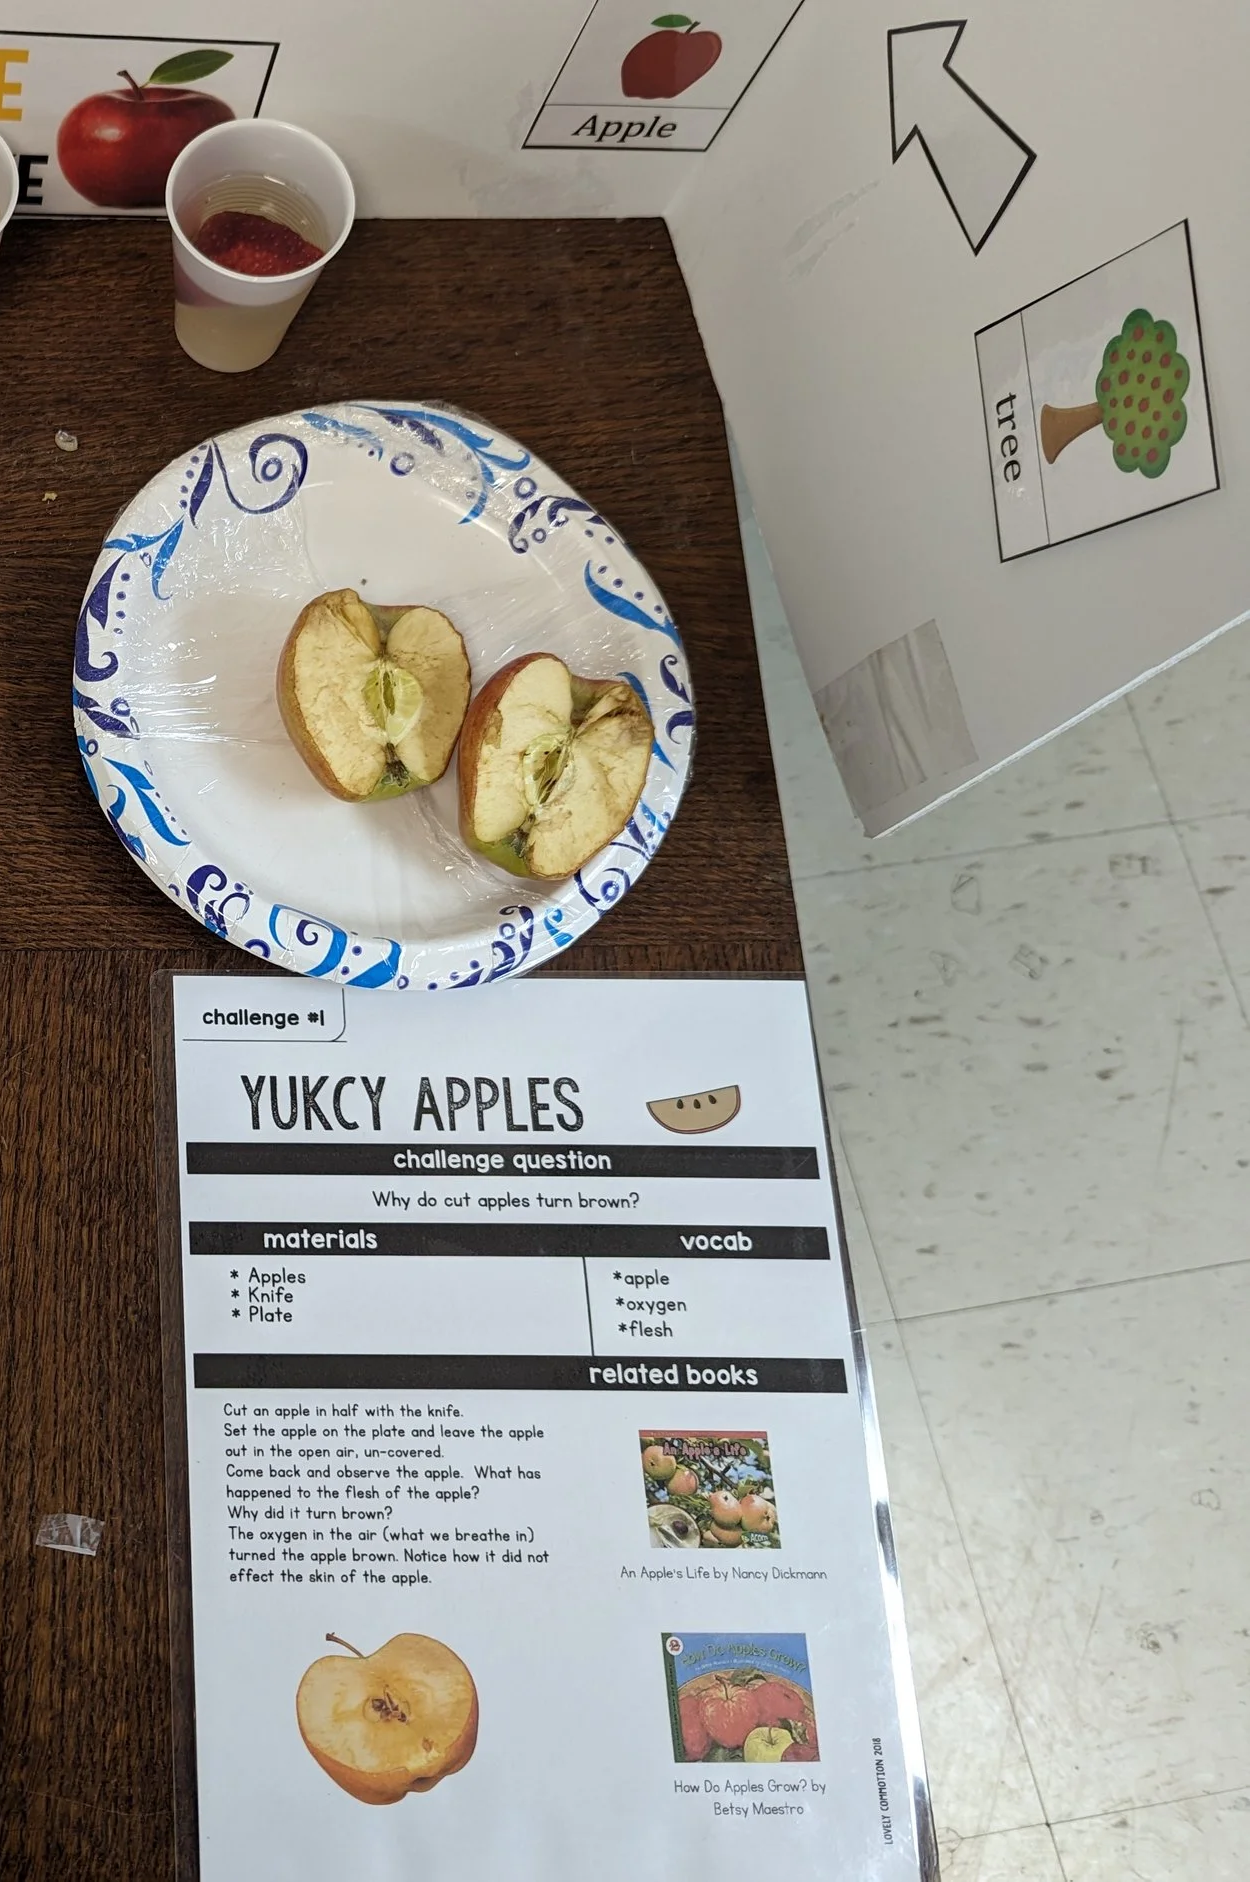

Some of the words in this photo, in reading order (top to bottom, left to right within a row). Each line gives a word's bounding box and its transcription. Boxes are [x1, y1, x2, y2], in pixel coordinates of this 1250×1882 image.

[572, 114, 678, 143] Apple
[996, 393, 1023, 484] tree
[203, 1008, 299, 1030] challenge
[308, 1010, 324, 1026] #1
[241, 1074, 386, 1131] YUKCY
[414, 1076, 583, 1132] APPLES
[394, 1149, 504, 1174] challenge
[513, 1150, 611, 1174] question
[372, 1191, 410, 1211] Why
[418, 1191, 437, 1207] do
[444, 1192, 470, 1207] cut
[478, 1191, 530, 1211] apples
[536, 1192, 572, 1208] turn
[578, 1191, 639, 1208] brown?
[264, 1229, 377, 1249] materials
[680, 1231, 752, 1251] vocab
[249, 1267, 305, 1288] Apples
[624, 1268, 669, 1288] apple
[249, 1286, 293, 1303] Knife
[249, 1305, 292, 1323] Plate
[626, 1298, 686, 1316] oxygen
[630, 1320, 672, 1337] flesh
[589, 1363, 678, 1385] related
[686, 1364, 758, 1386] books
[224, 1402, 247, 1416] Cut
[254, 1407, 269, 1416] an
[275, 1403, 310, 1419] apple
[316, 1408, 326, 1417] in
[332, 1404, 358, 1417] half
[365, 1404, 394, 1417] with
[400, 1404, 421, 1418] the
[428, 1404, 464, 1418] knife.
[226, 1444, 247, 1457] out
[254, 1446, 264, 1457] in
[270, 1444, 292, 1457] the
[299, 1449, 330, 1460] open
[336, 1446, 358, 1459] air,
[365, 1444, 445, 1458] un-covered.
[621, 1566, 636, 1579] An
[641, 1566, 683, 1582] Apple's
[686, 1566, 710, 1579] Life
[713, 1567, 728, 1582] by
[732, 1567, 768, 1582] Nancy
[772, 1566, 827, 1580] Dickmann
[871, 1737, 883, 1756] 2018
[674, 1780, 700, 1793] How
[704, 1779, 720, 1793] Do
[725, 1779, 764, 1796] Apples
[768, 1778, 807, 1793] Grow?
[811, 1779, 826, 1795] by
[875, 1759, 889, 1811] COMMOTION
[714, 1802, 748, 1819] Betsy
[753, 1802, 804, 1815] Maestro
[881, 1814, 894, 1845] LOVELY
